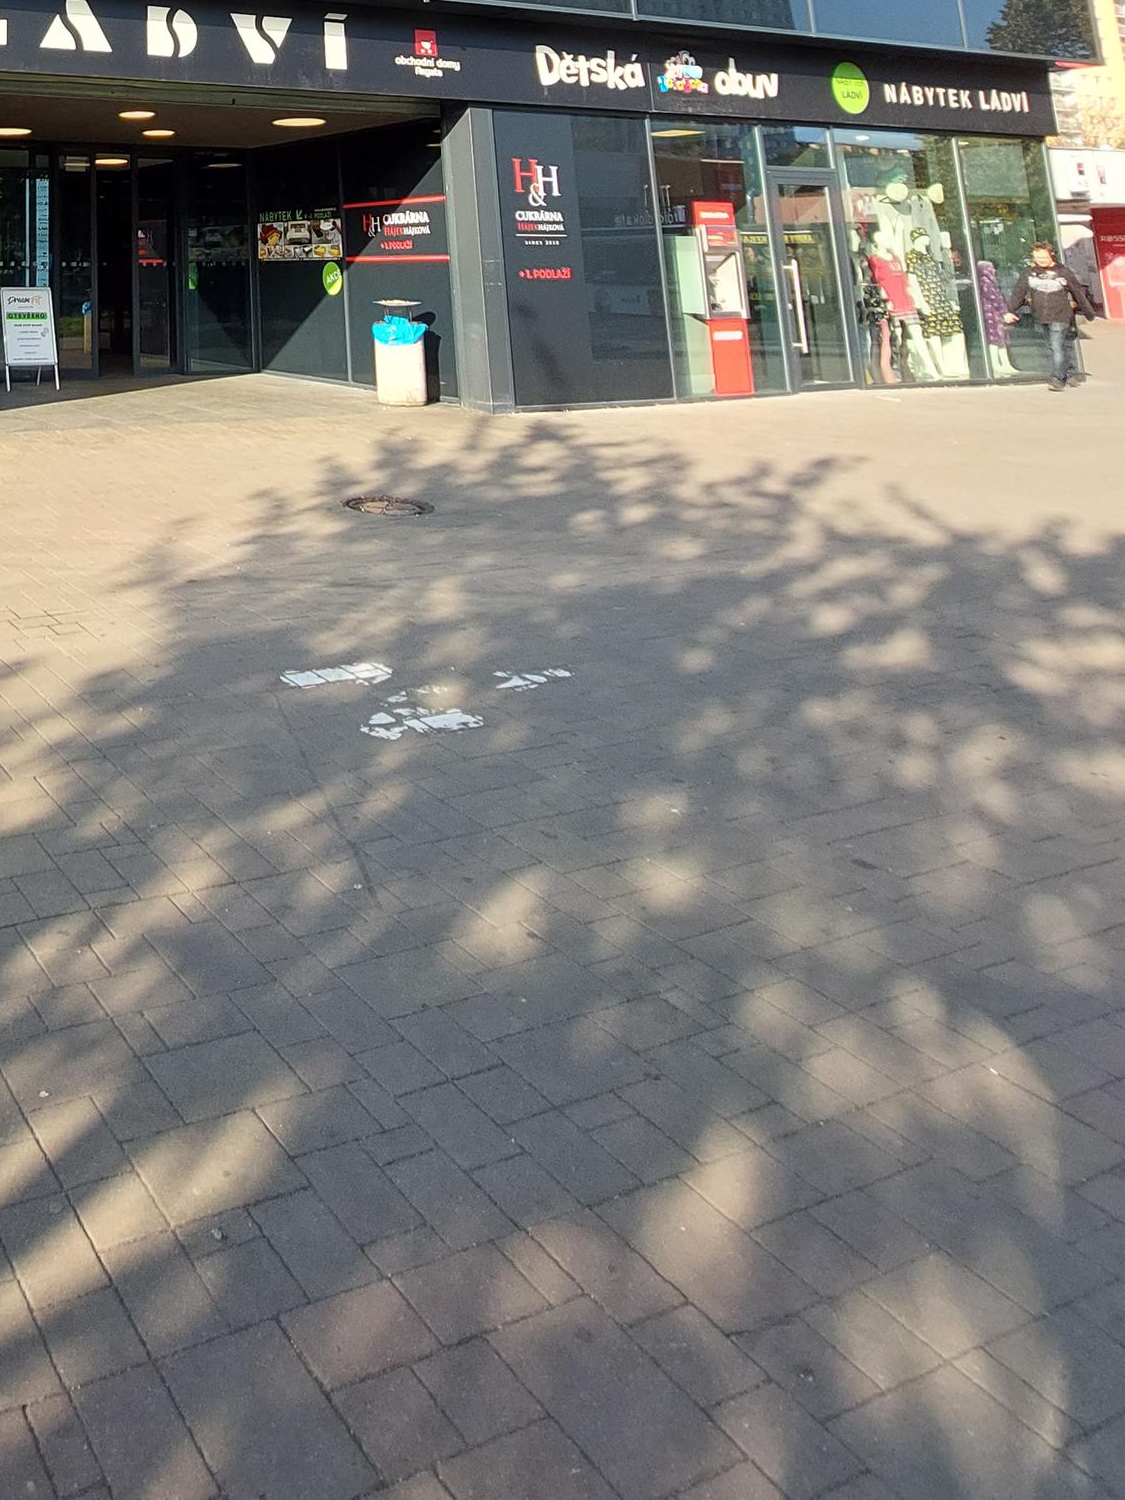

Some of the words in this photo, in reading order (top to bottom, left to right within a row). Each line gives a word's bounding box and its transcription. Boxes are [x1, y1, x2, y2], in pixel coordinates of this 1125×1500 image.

[395, 55, 435, 68] obchodní
[436, 58, 461, 71] domy
[535, 45, 646, 91] Dětská
[714, 57, 779, 99] obuv
[884, 82, 973, 109] NÁBYTEK
[979, 89, 1030, 113] LÁDVÍ
[515, 210, 564, 222] CUKRÁRNA
